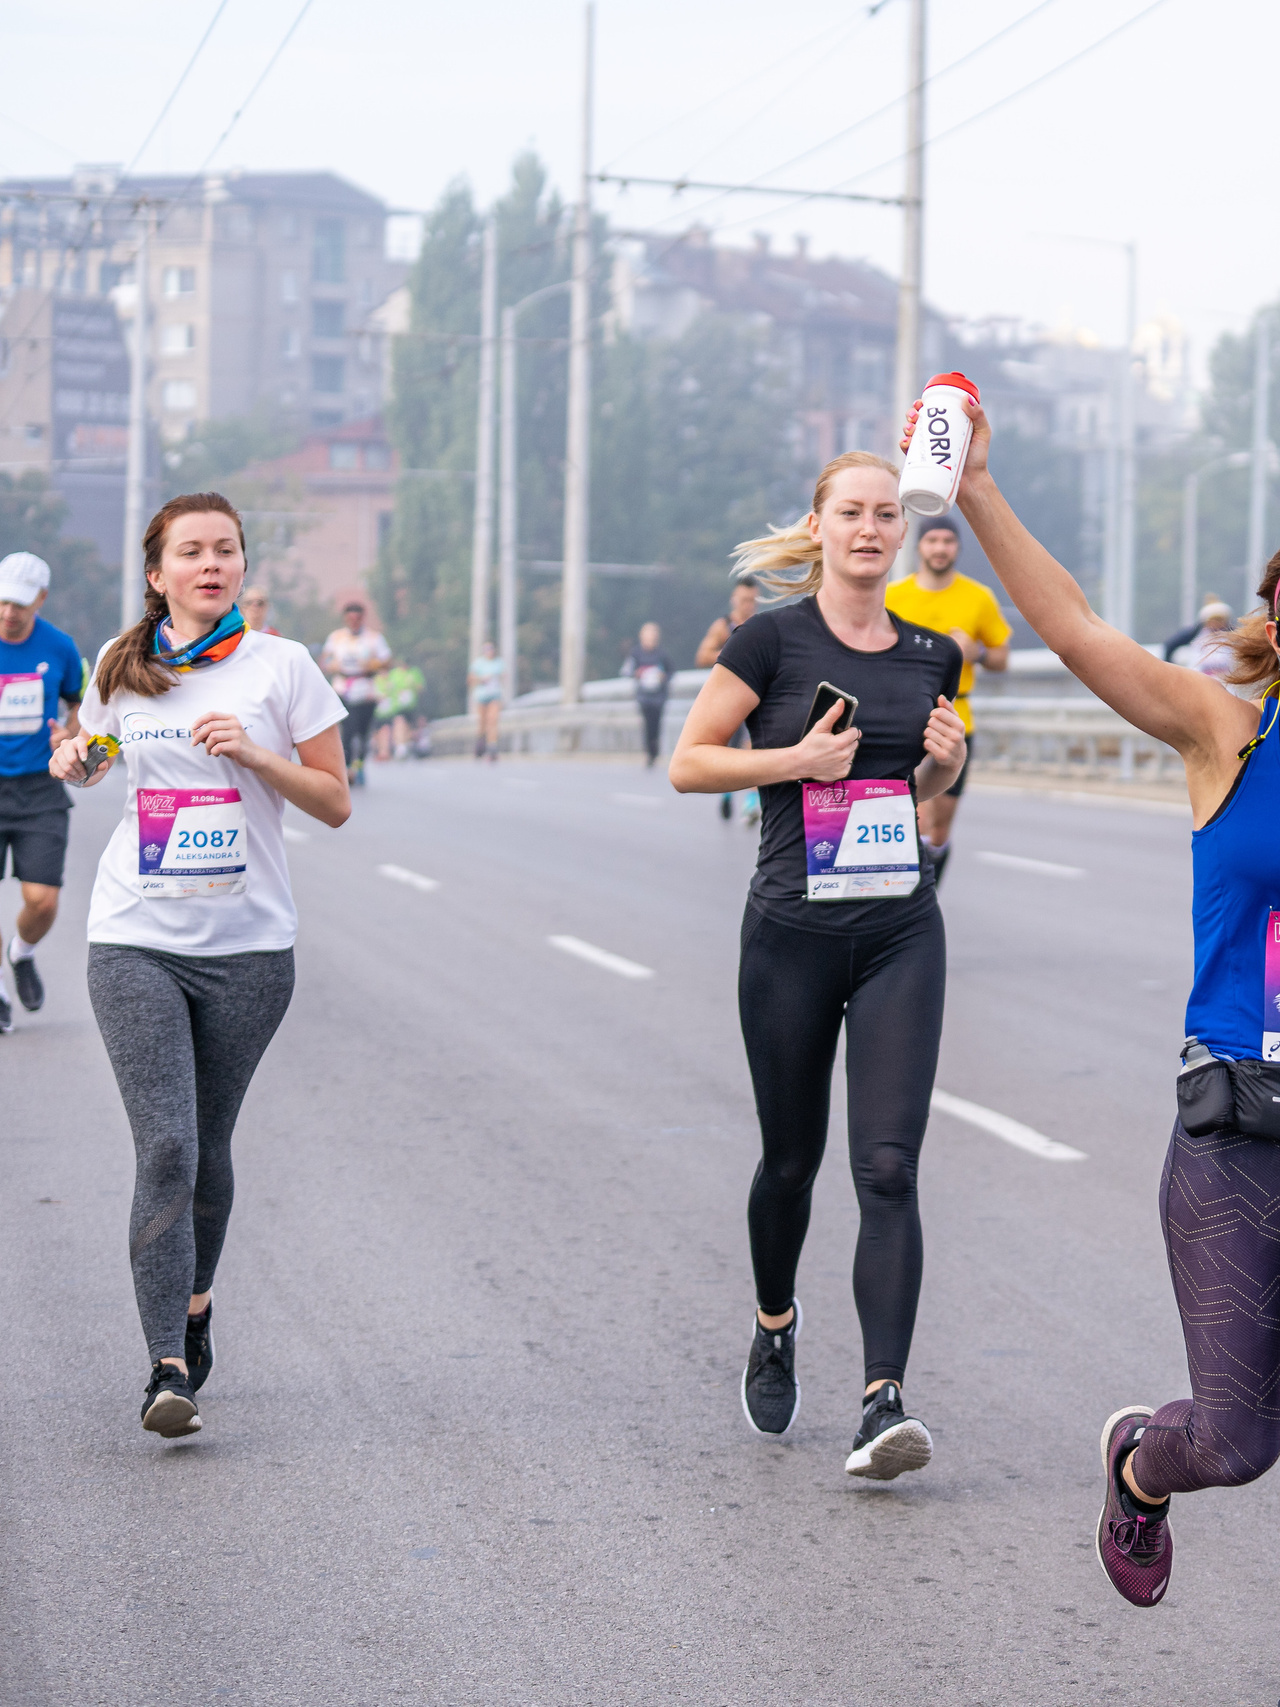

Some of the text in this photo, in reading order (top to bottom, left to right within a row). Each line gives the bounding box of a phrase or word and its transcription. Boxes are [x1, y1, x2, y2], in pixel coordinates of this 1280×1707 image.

[927, 407, 952, 471] BORN
[124, 728, 192, 743] CONCE
[178, 829, 239, 848] 2087
[857, 824, 905, 843] 2156
